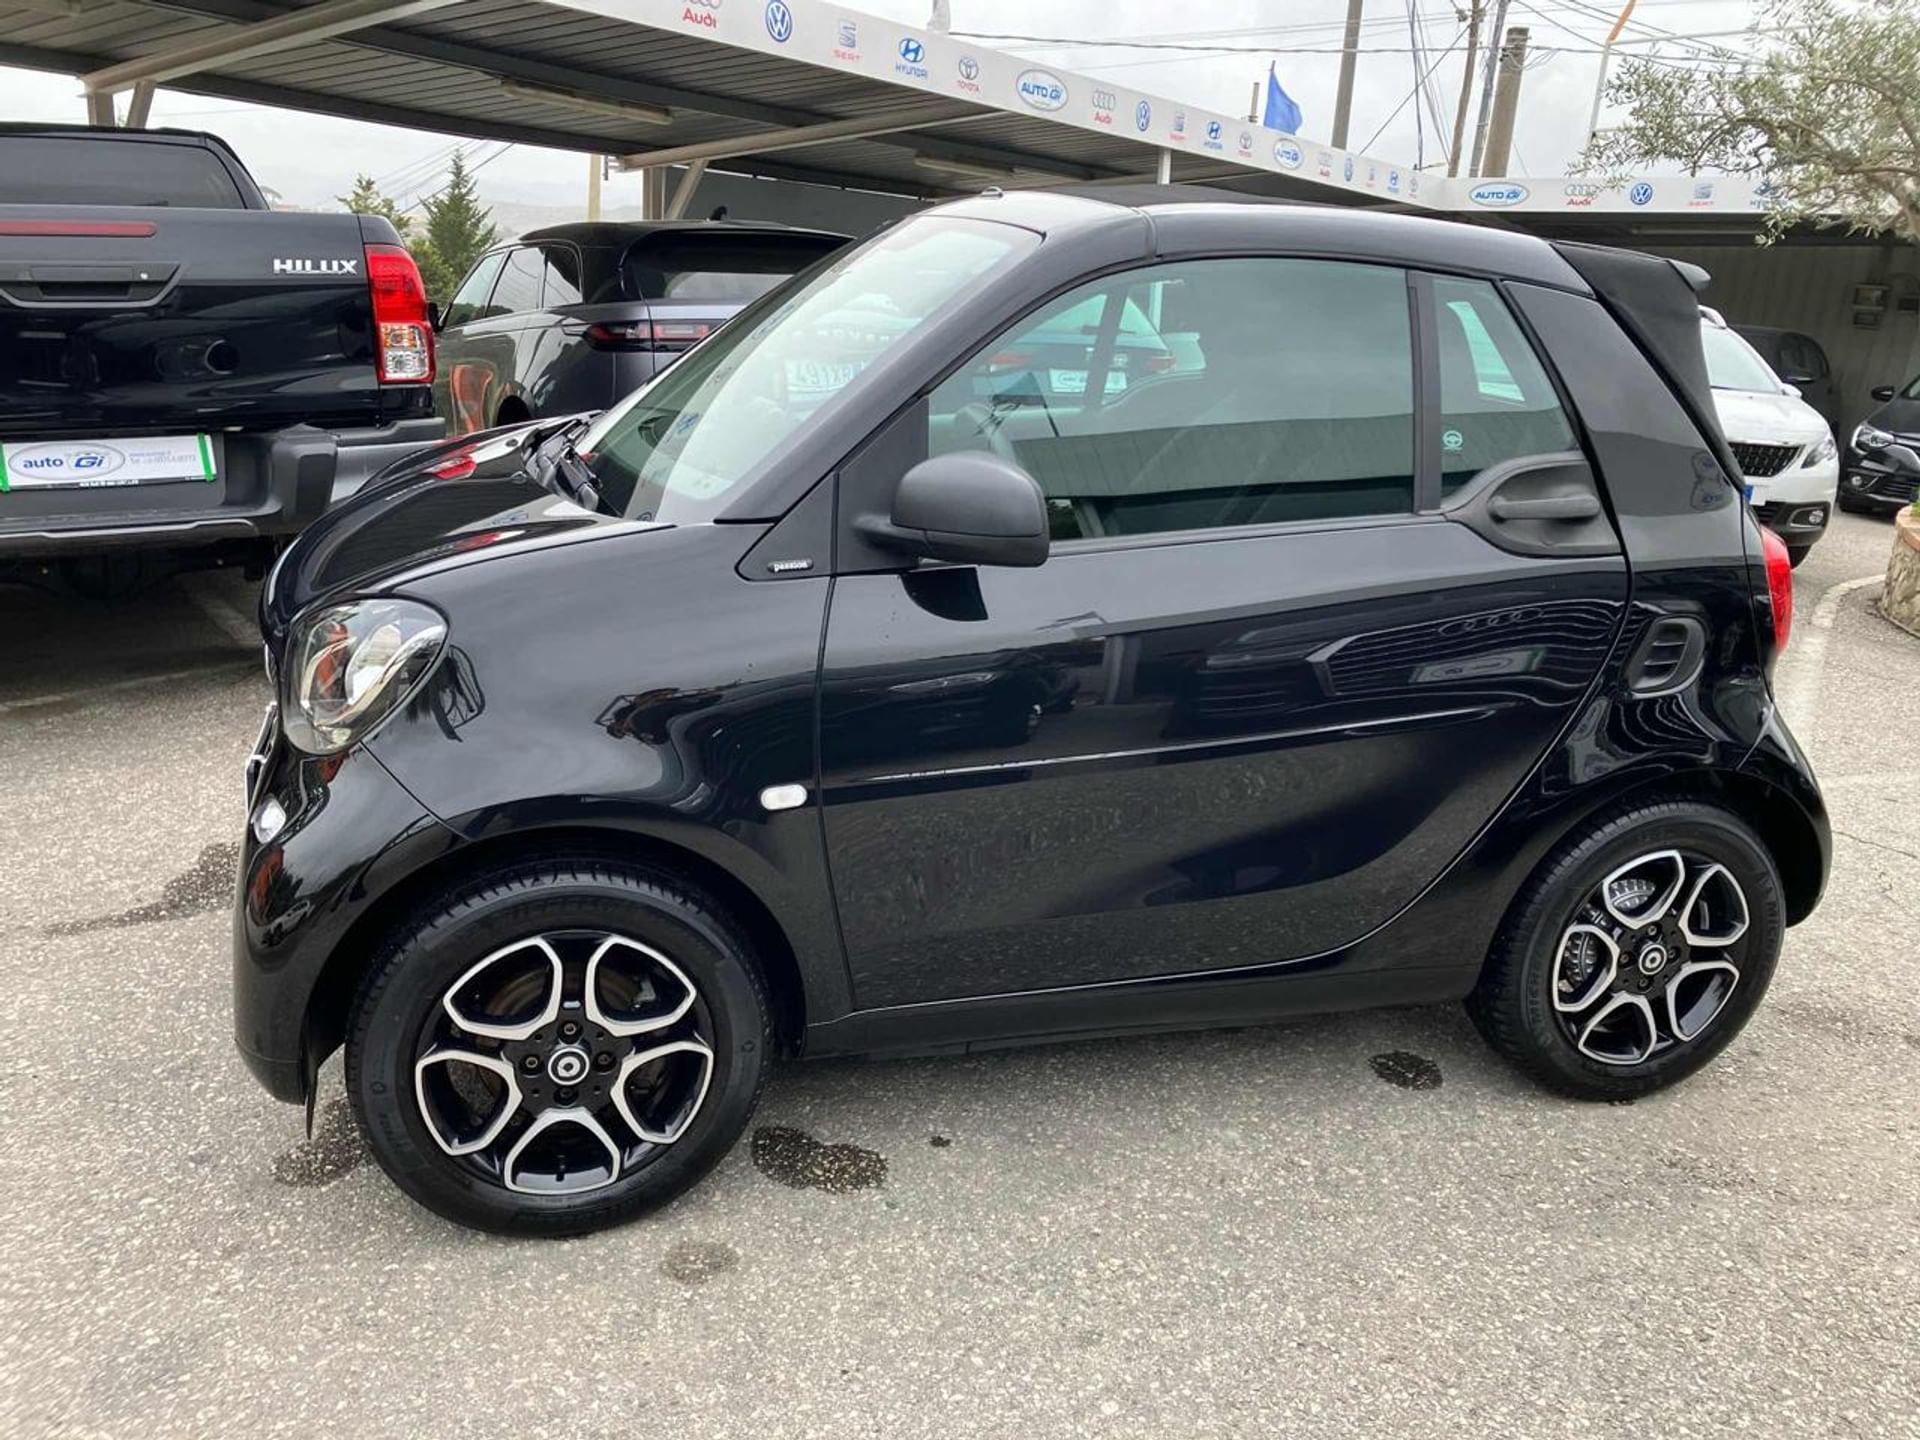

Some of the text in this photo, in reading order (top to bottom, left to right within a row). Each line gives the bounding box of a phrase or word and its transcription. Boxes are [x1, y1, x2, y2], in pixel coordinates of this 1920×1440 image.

[682, 7, 717, 29] Audi
[1021, 82, 1048, 98] AUTO
[1475, 191, 1504, 200] AUTO
[273, 258, 358, 275] HILUX
[23, 456, 64, 469] auto
